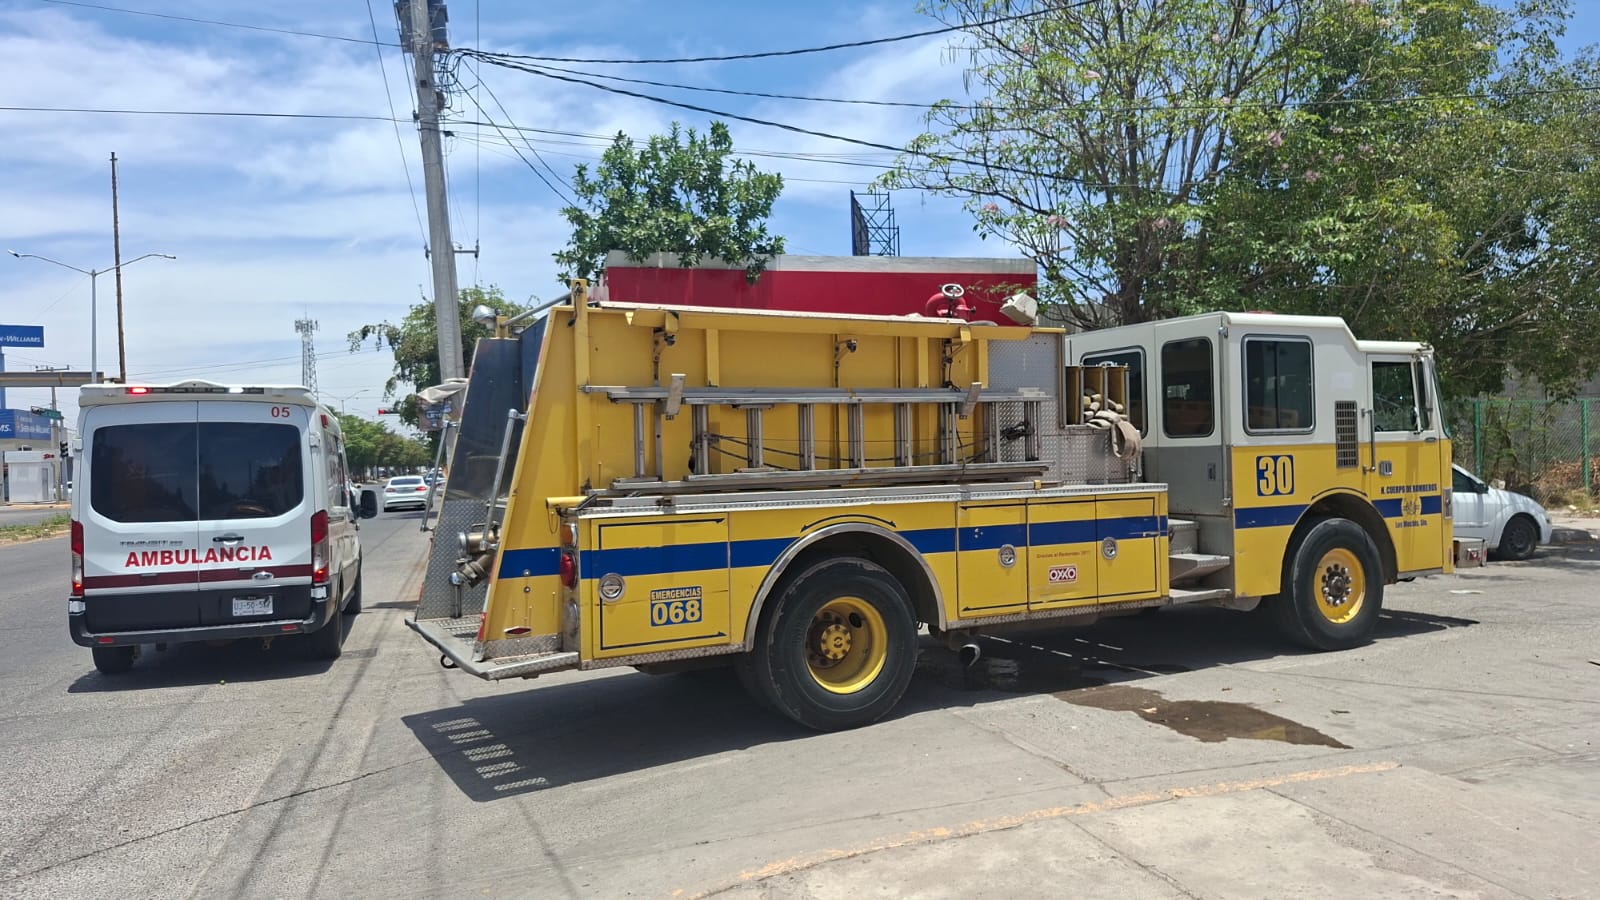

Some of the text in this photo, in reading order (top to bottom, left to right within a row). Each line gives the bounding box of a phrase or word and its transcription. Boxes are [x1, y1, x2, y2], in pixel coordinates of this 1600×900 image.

[271, 406, 290, 418] 05
[1259, 456, 1293, 496] 30
[125, 545, 272, 567] AMBULANCIA
[1050, 567, 1076, 581] OXXO
[651, 587, 701, 600] EMERGENCIAS
[653, 600, 700, 625] 068
